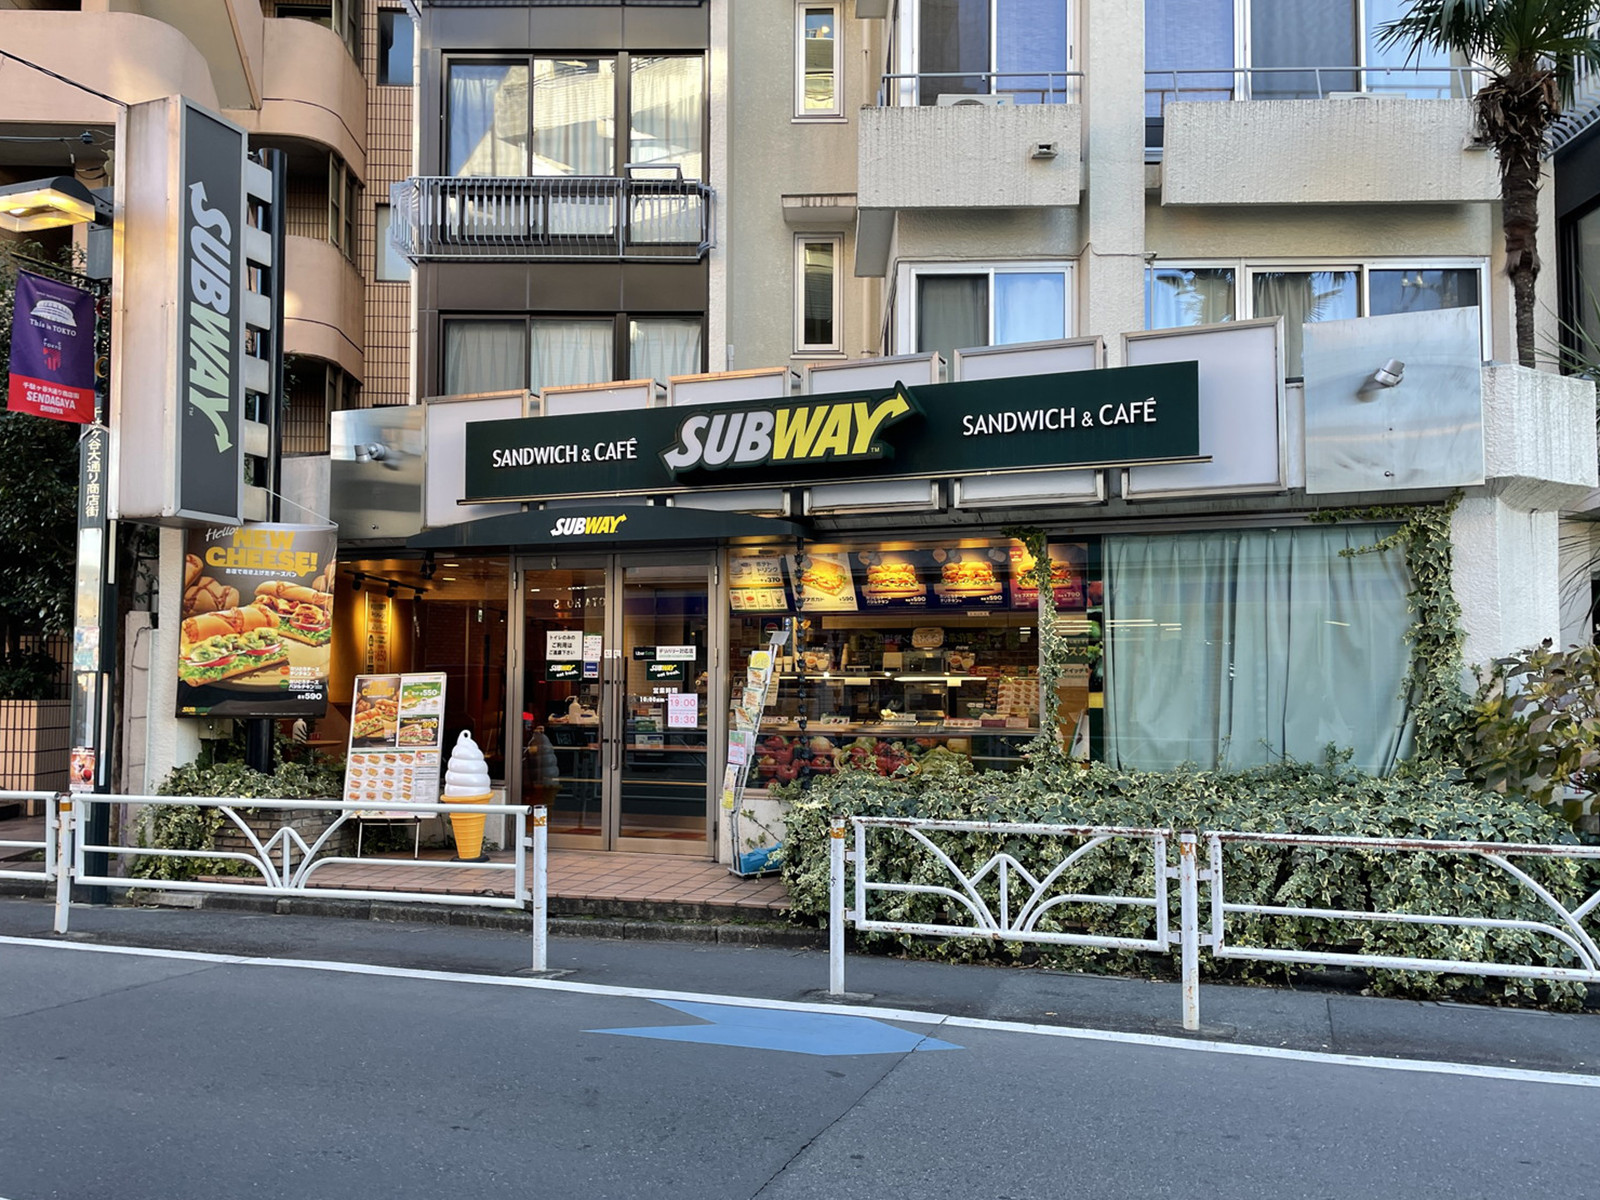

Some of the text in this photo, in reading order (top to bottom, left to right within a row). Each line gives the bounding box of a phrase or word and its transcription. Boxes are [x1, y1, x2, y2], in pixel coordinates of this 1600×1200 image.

[29, 318, 45, 328] This
[52, 325, 77, 337] TOKYO
[189, 181, 233, 453] SUBWAY
[26, 391, 76, 410] SENDAGAYA
[962, 397, 1157, 436] SANDWICH & CAFÉ
[663, 392, 910, 471] SUBWAY
[492, 437, 638, 468] SANDWICH & CAFÉ
[205, 526, 239, 542] Hello!
[550, 514, 627, 537] SUBWAY
[233, 528, 296, 550] NEW
[205, 546, 318, 577] CHEESE!
[670, 699, 696, 707] 19:00
[670, 715, 696, 724] 18:30
